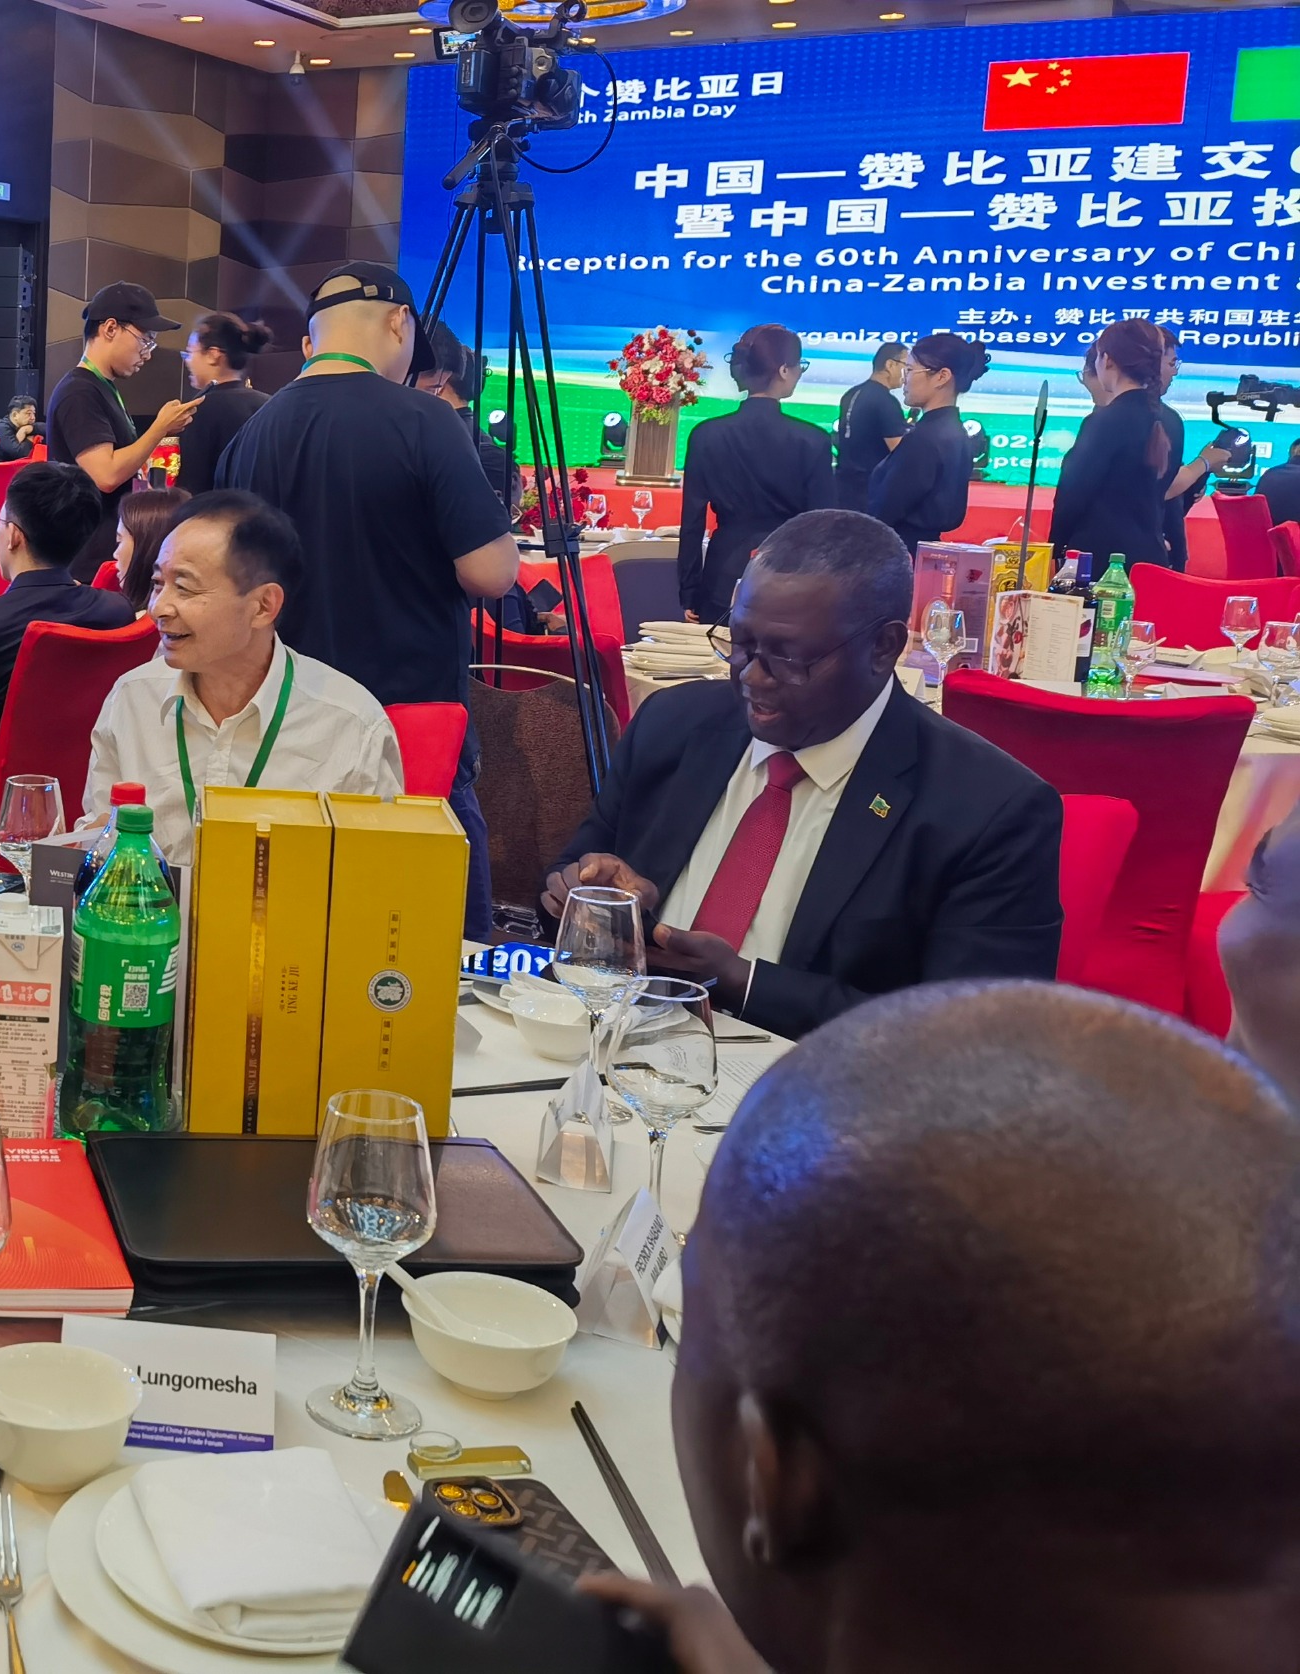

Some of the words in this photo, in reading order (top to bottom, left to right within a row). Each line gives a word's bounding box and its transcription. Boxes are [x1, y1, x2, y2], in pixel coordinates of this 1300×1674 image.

[603, 105, 686, 123] Zambia
[692, 103, 737, 119] Day
[517, 252, 670, 275] Reception
[682, 250, 733, 270] for
[743, 249, 804, 269] the
[815, 246, 900, 267] 60th
[913, 244, 1156, 267] Anniversary
[1169, 241, 1216, 263] of
[760, 272, 1027, 294] China-Zambia
[1042, 271, 1282, 292] Investment
[796, 329, 919, 345] rganizer:
[136, 1364, 258, 1396] Lungomesha
